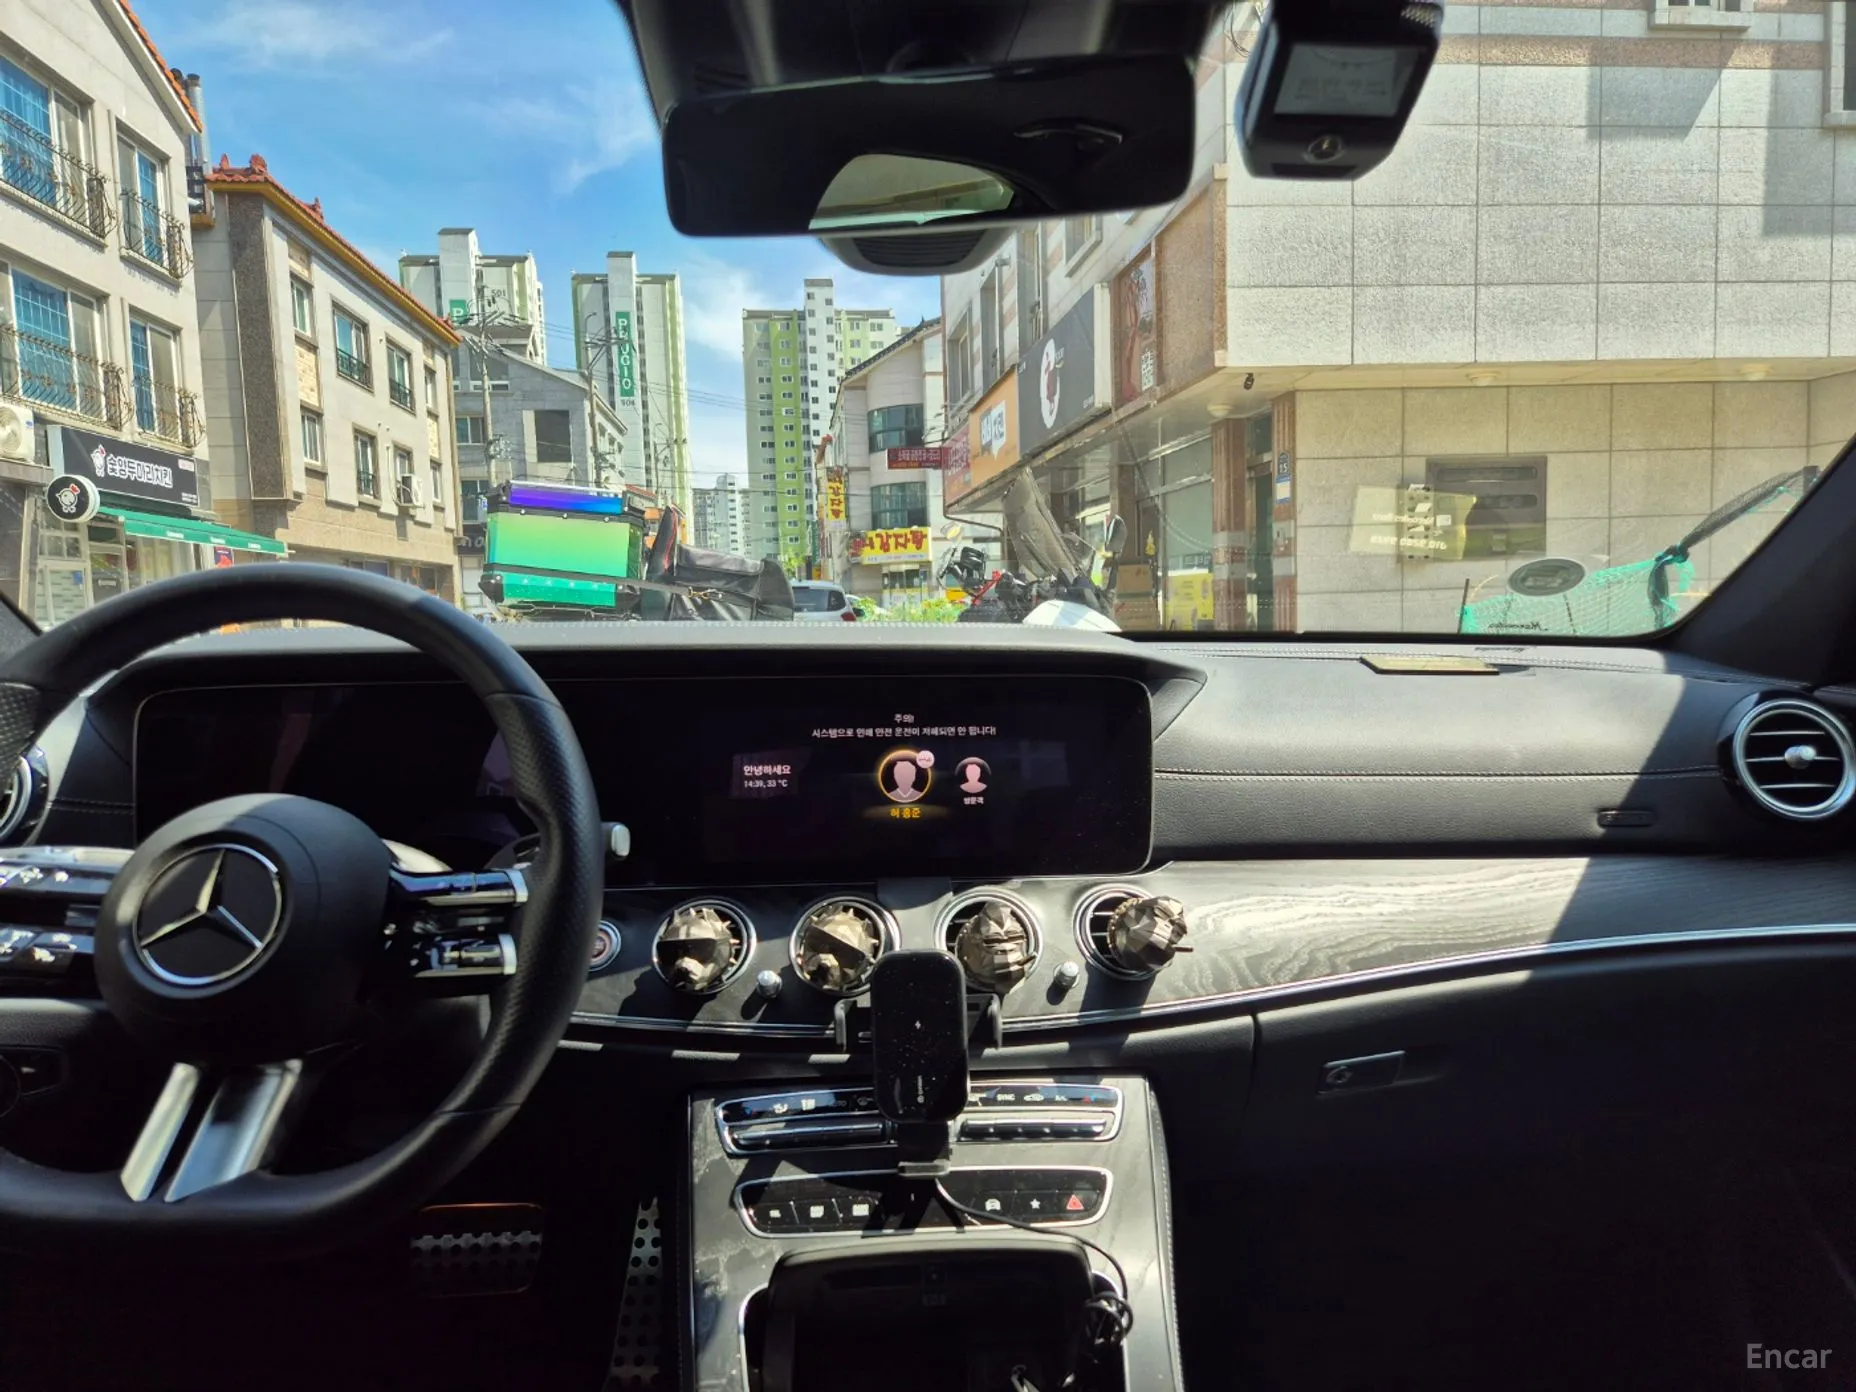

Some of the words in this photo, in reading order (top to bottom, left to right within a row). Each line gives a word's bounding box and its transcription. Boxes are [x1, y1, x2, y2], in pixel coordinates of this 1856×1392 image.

[811, 728, 855, 739] 시스템으로
[875, 727, 893, 737] 안전
[894, 726, 920, 737] 운전이
[957, 726, 967, 736] 안
[968, 725, 997, 736] 됩니다!
[743, 764, 792, 776] 안녕하세요
